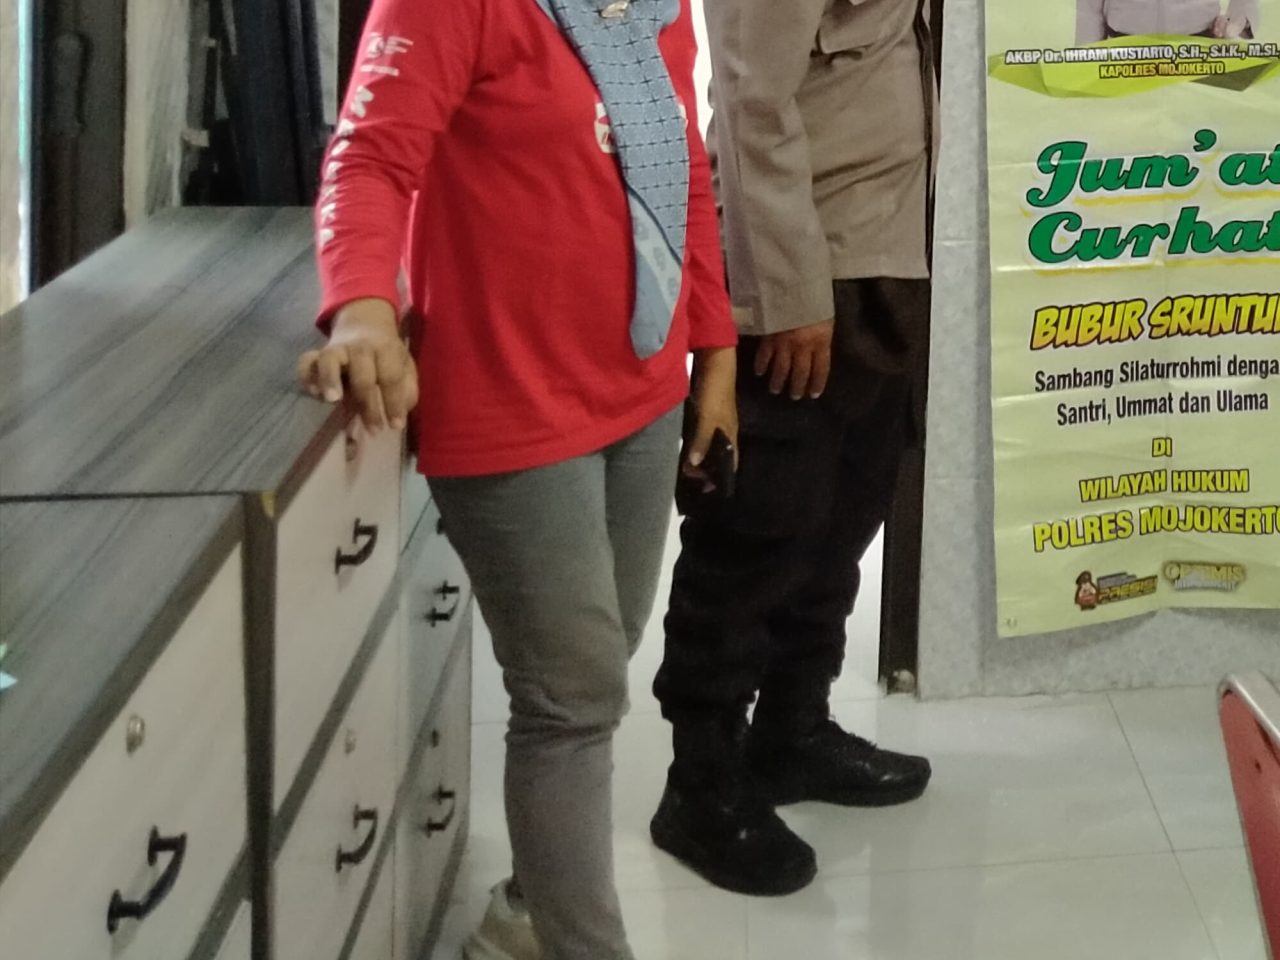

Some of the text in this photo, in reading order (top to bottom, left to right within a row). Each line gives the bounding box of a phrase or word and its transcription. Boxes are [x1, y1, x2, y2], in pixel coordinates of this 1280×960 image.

[1005, 49, 1041, 64] AKBP
[1044, 49, 1063, 62] Dr.
[1065, 48, 1108, 62] IHRAM
[1110, 45, 1176, 61] KUSTARTO,
[1100, 61, 1225, 79] KAPOLRES MOJOKERTO
[1030, 298, 1148, 351] BUBUR
[1035, 368, 1114, 393] Sambang
[1119, 356, 1222, 384] Silaturrohmi
[1057, 390, 1268, 426] Santri, Ummat dan Ulama
[1152, 437, 1173, 458] DI
[1079, 469, 1250, 502] WILAYAH HUKUM
[1033, 510, 1134, 552] POLRES
